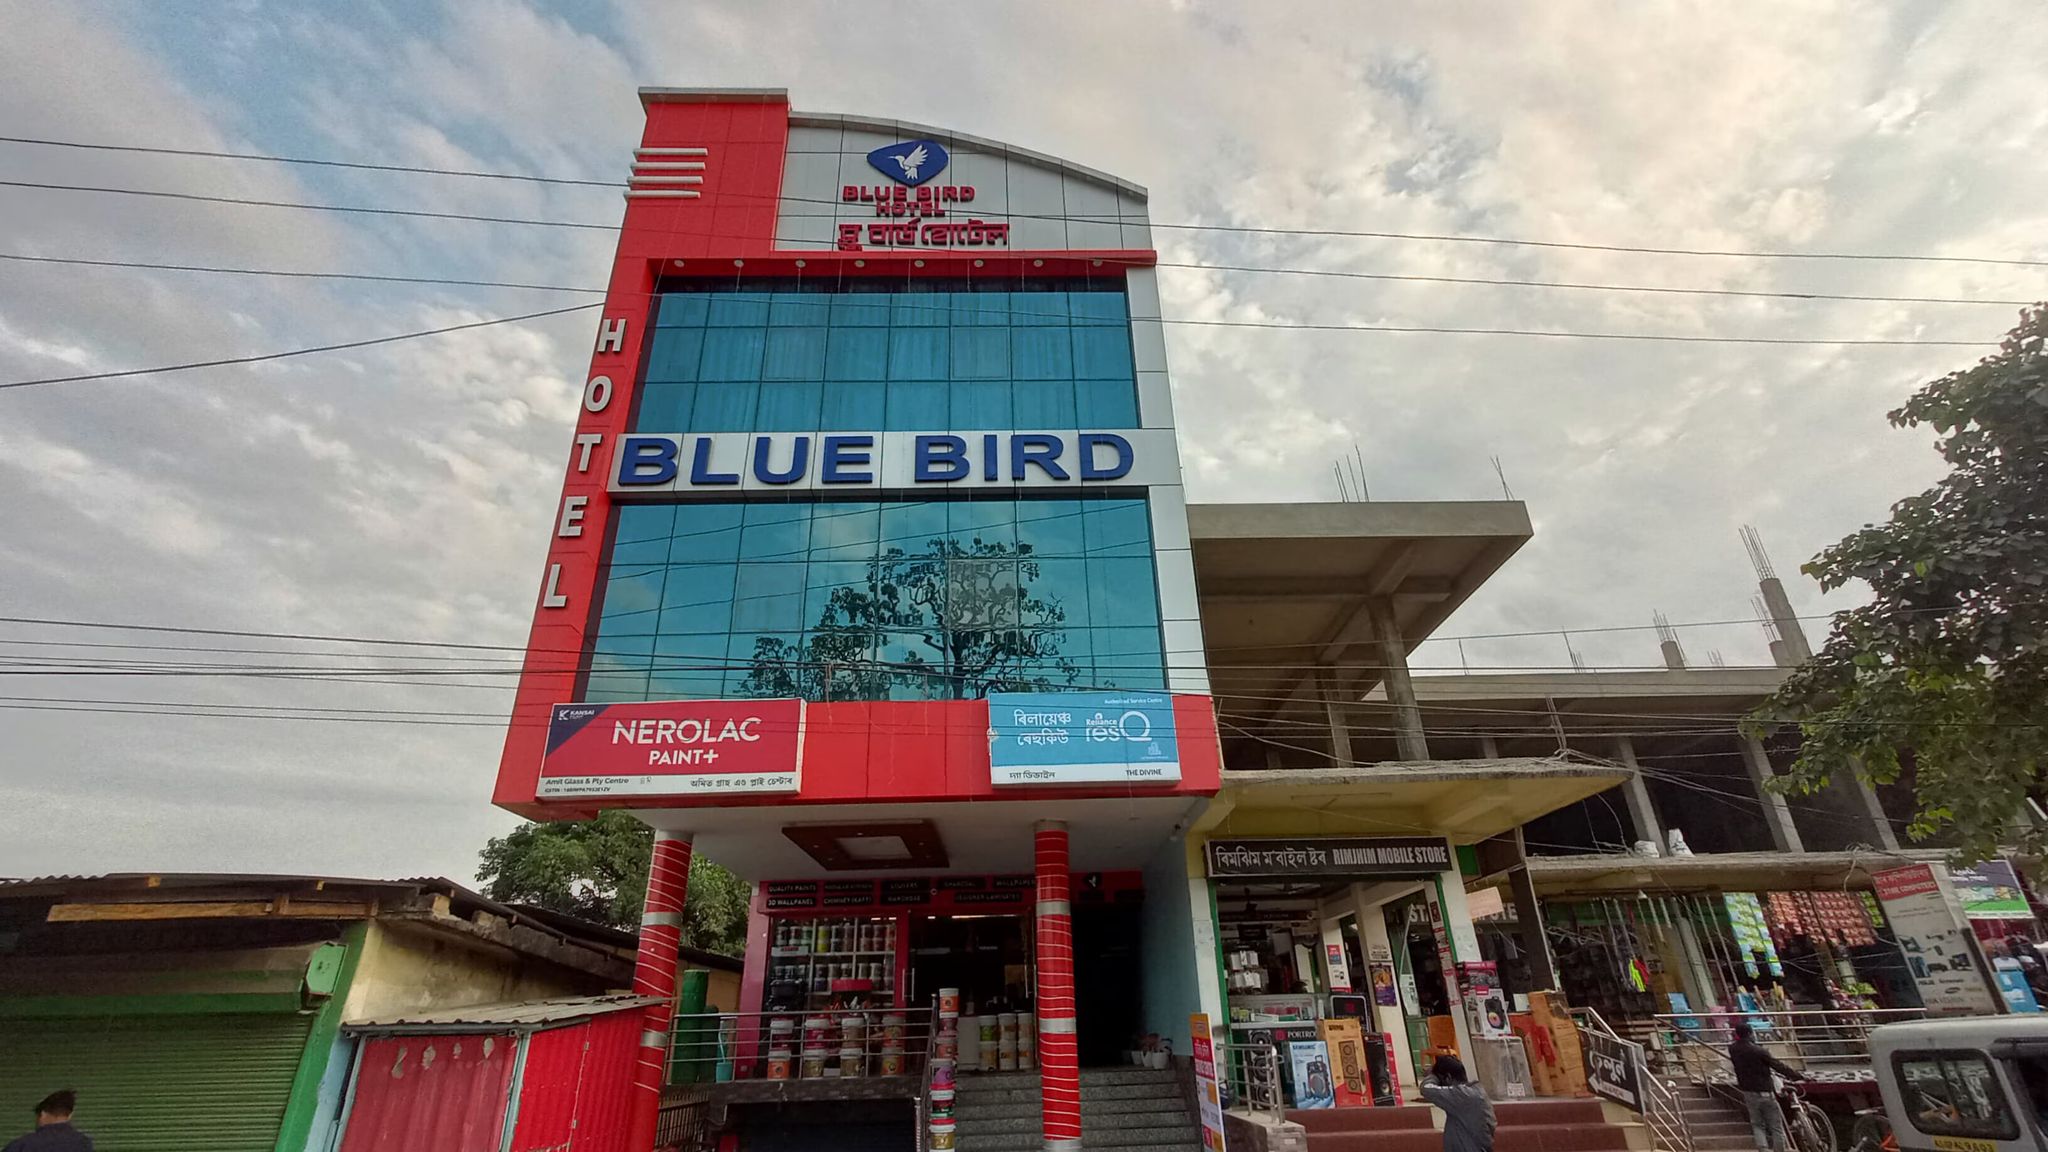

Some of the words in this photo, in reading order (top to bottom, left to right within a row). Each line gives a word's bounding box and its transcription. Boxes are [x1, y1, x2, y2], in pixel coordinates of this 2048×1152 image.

[842, 186, 907, 201] BLUE
[916, 186, 975, 201] BIRD
[876, 202, 946, 217] HOTEL
[921, 219, 1010, 245] হোটেল
[543, 319, 627, 608] HOTEL
[618, 435, 874, 486] BLUE
[914, 434, 1135, 483] BIRD
[1085, 711, 1152, 742] resQ
[1086, 715, 1117, 726] Reliance
[612, 717, 762, 744] NEROLAC
[648, 749, 719, 765] PAINT+
[1126, 769, 1138, 777] THE
[1139, 768, 1162, 776] DIVINE
[592, 777, 603, 786] Ply
[1332, 848, 1377, 865] RIMJHIM
[1377, 847, 1415, 864] MOBILE
[1415, 846, 1447, 864] STORE
[777, 898, 814, 906] WALLPANEL
